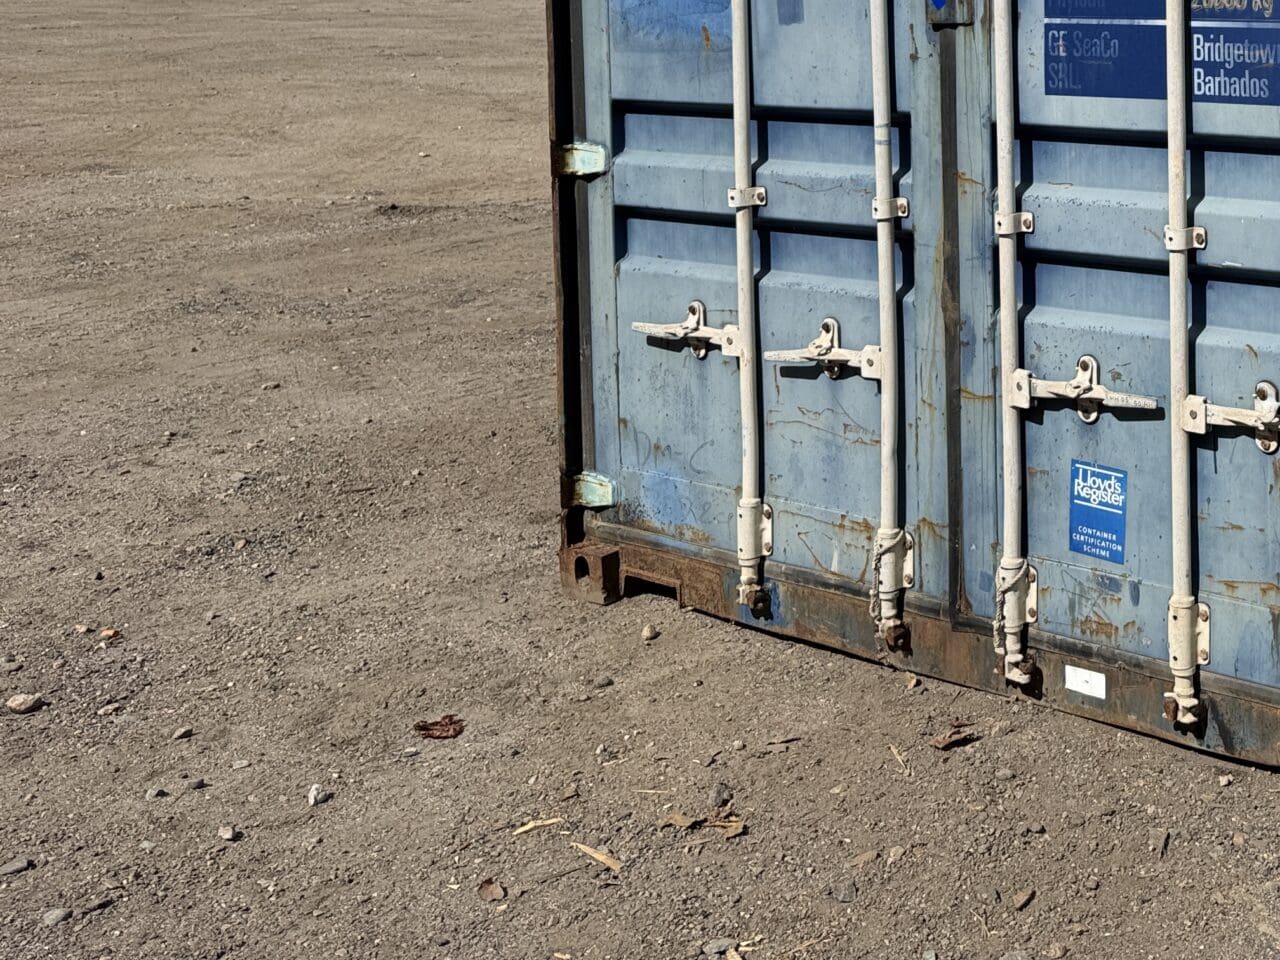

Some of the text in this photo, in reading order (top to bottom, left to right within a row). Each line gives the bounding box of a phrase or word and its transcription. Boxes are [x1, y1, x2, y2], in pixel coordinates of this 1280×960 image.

[1048, 30, 1068, 57] GE
[1192, 67, 1270, 99] Barbados
[1074, 479, 1124, 507] Register
[1072, 533, 1122, 552] CERTIFICATION
[1077, 525, 1117, 541] CONTAINER
[1083, 545, 1110, 558] SCHEME
